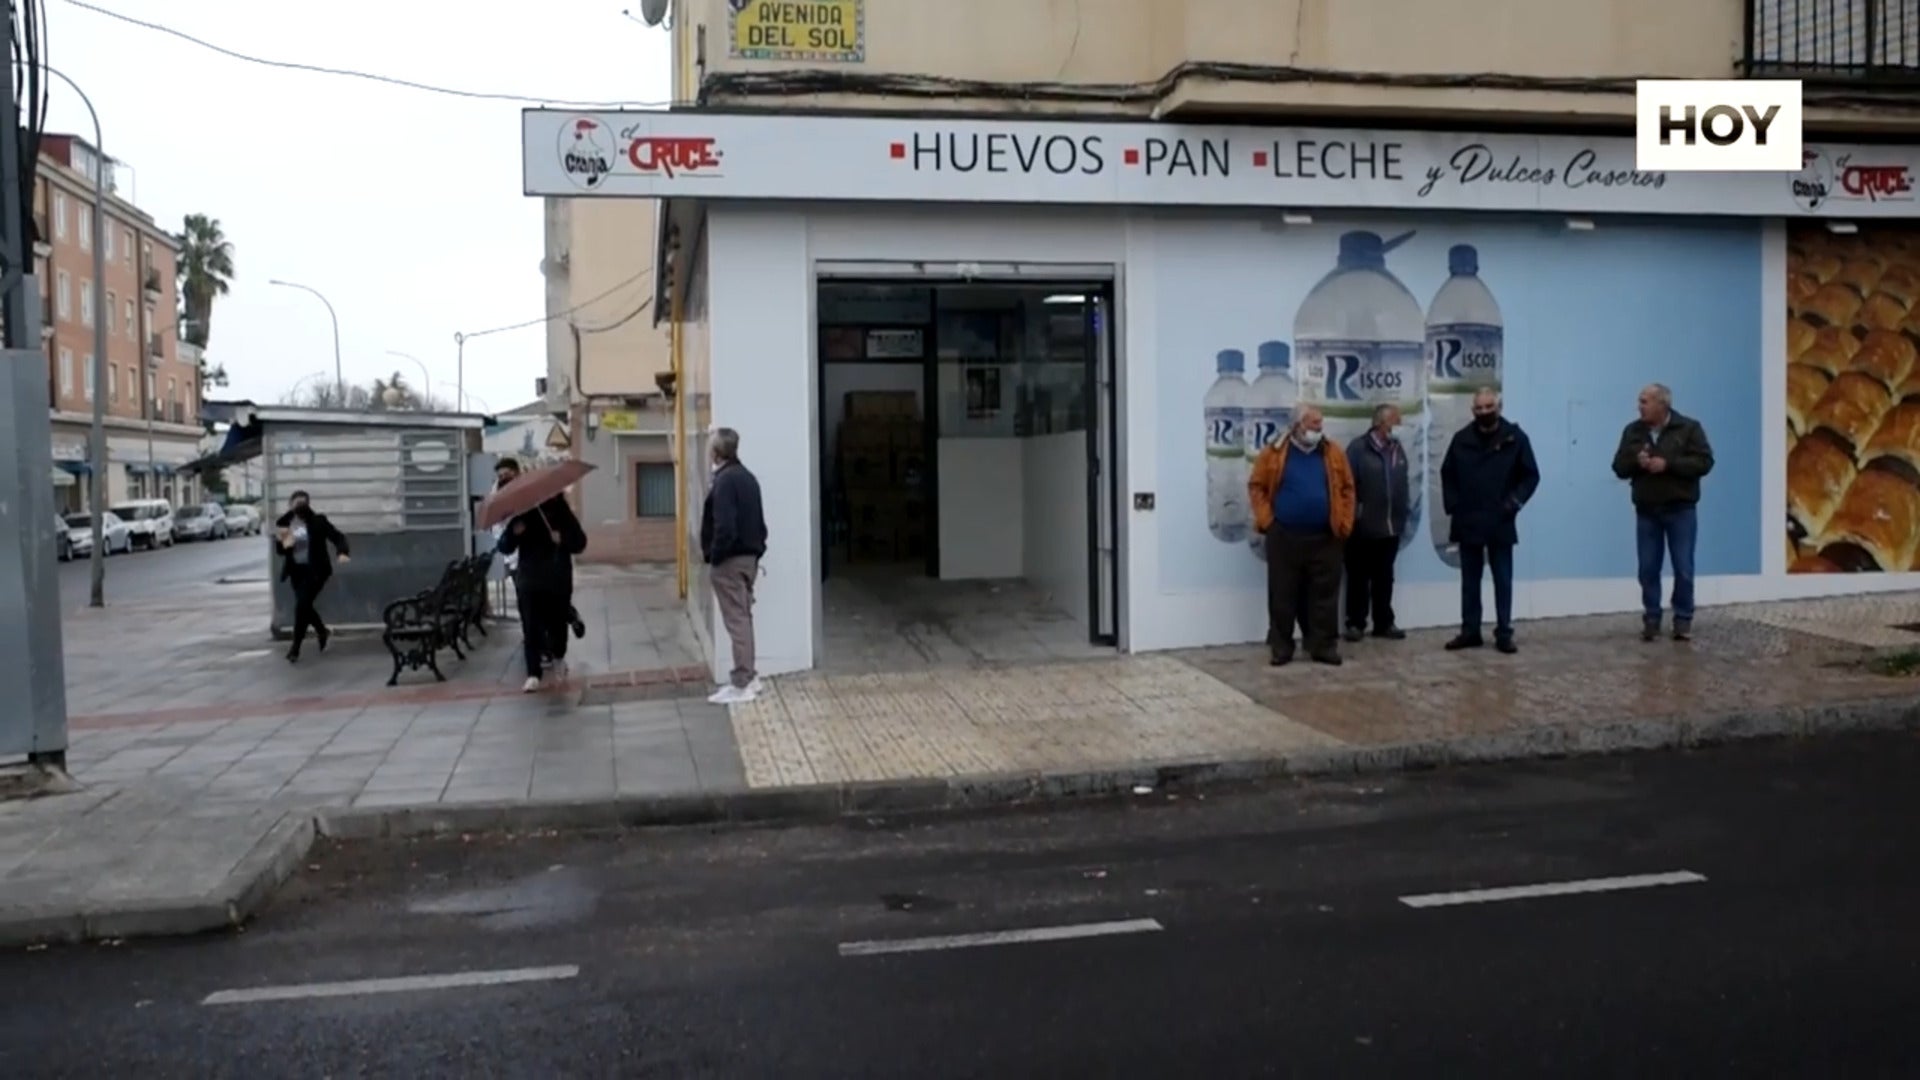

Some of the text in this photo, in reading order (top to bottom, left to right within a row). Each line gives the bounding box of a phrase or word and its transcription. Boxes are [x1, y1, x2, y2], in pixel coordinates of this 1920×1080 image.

[758, 2, 842, 25] AVENIDA
[748, 25, 853, 50] DEL SOL
[628, 137, 719, 179] CRUCE
[913, 132, 1666, 198] HUEVOS PAN LECHE y Dulces Caseros
[1325, 354, 1402, 400] Riscos
